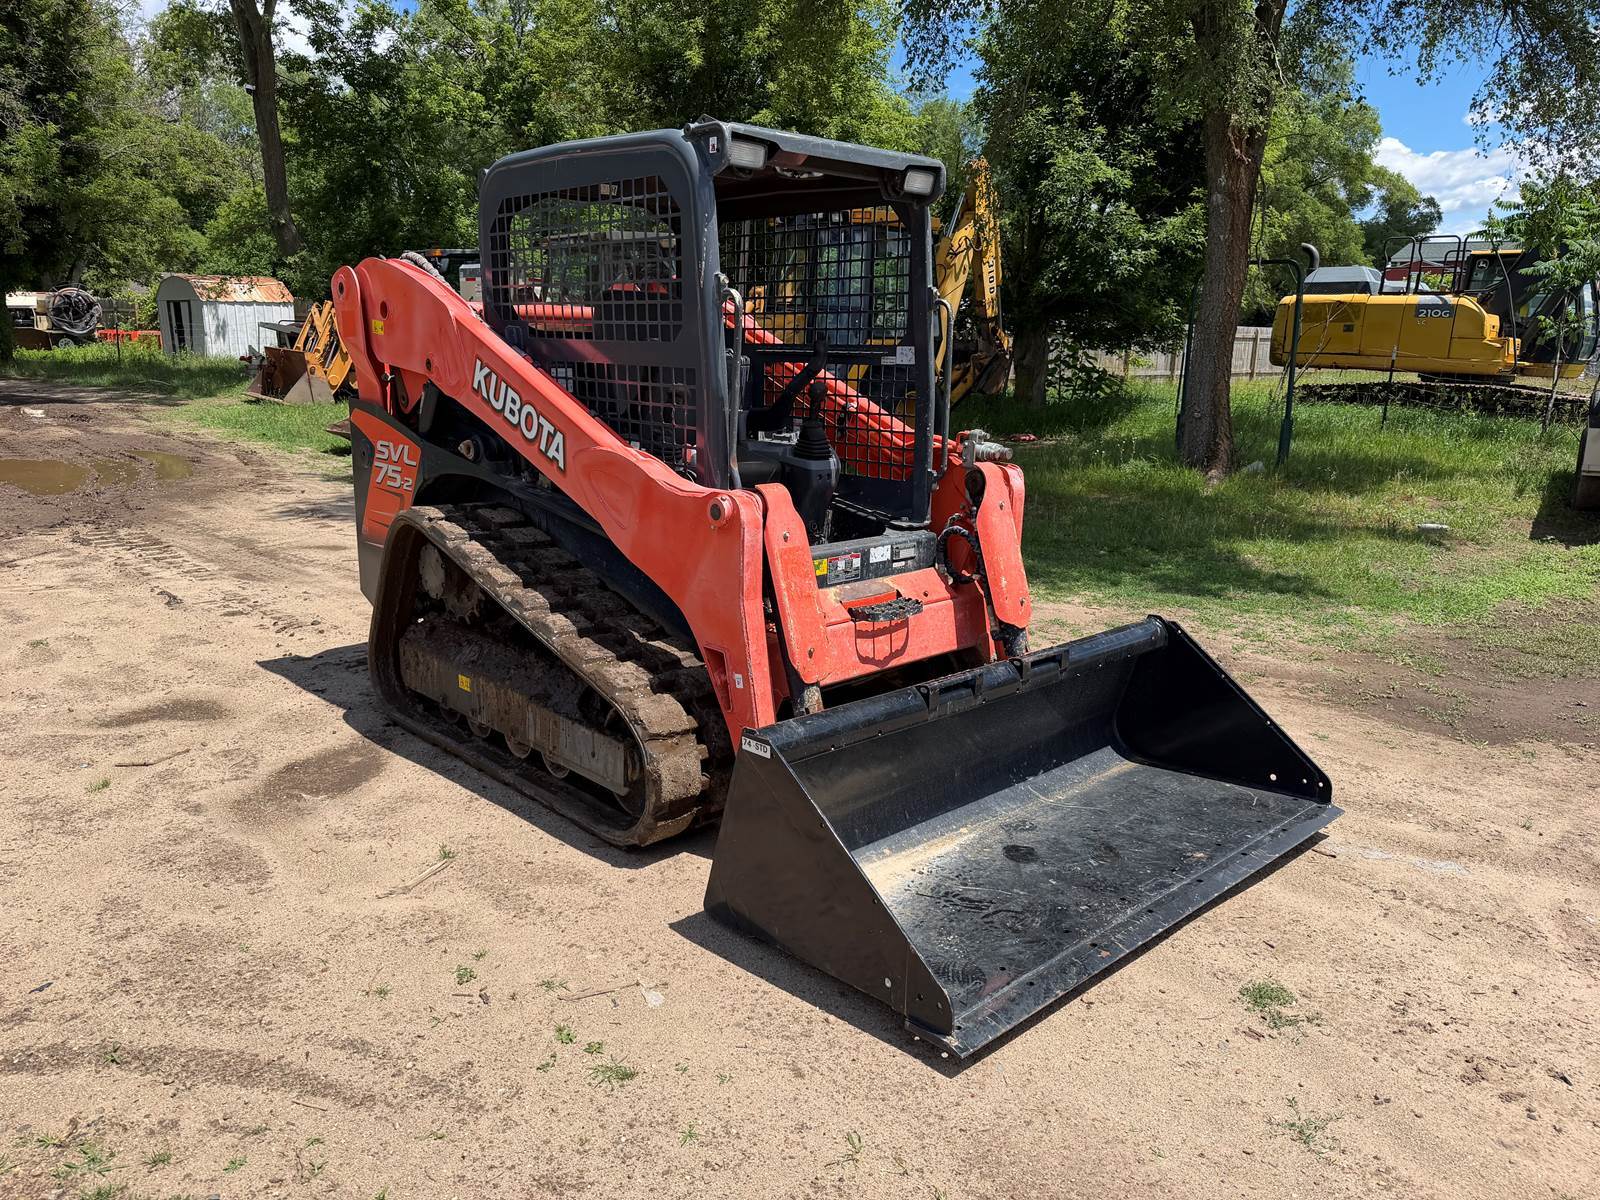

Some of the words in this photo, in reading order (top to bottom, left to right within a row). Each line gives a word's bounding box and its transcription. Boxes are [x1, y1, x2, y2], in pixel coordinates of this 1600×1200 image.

[1418, 309, 1450, 317] 210G
[472, 358, 565, 470] KUBOTA
[375, 440, 417, 467] SVL
[374, 461, 413, 491] 75-2
[743, 738, 752, 748] 74
[754, 742, 768, 753] STD
